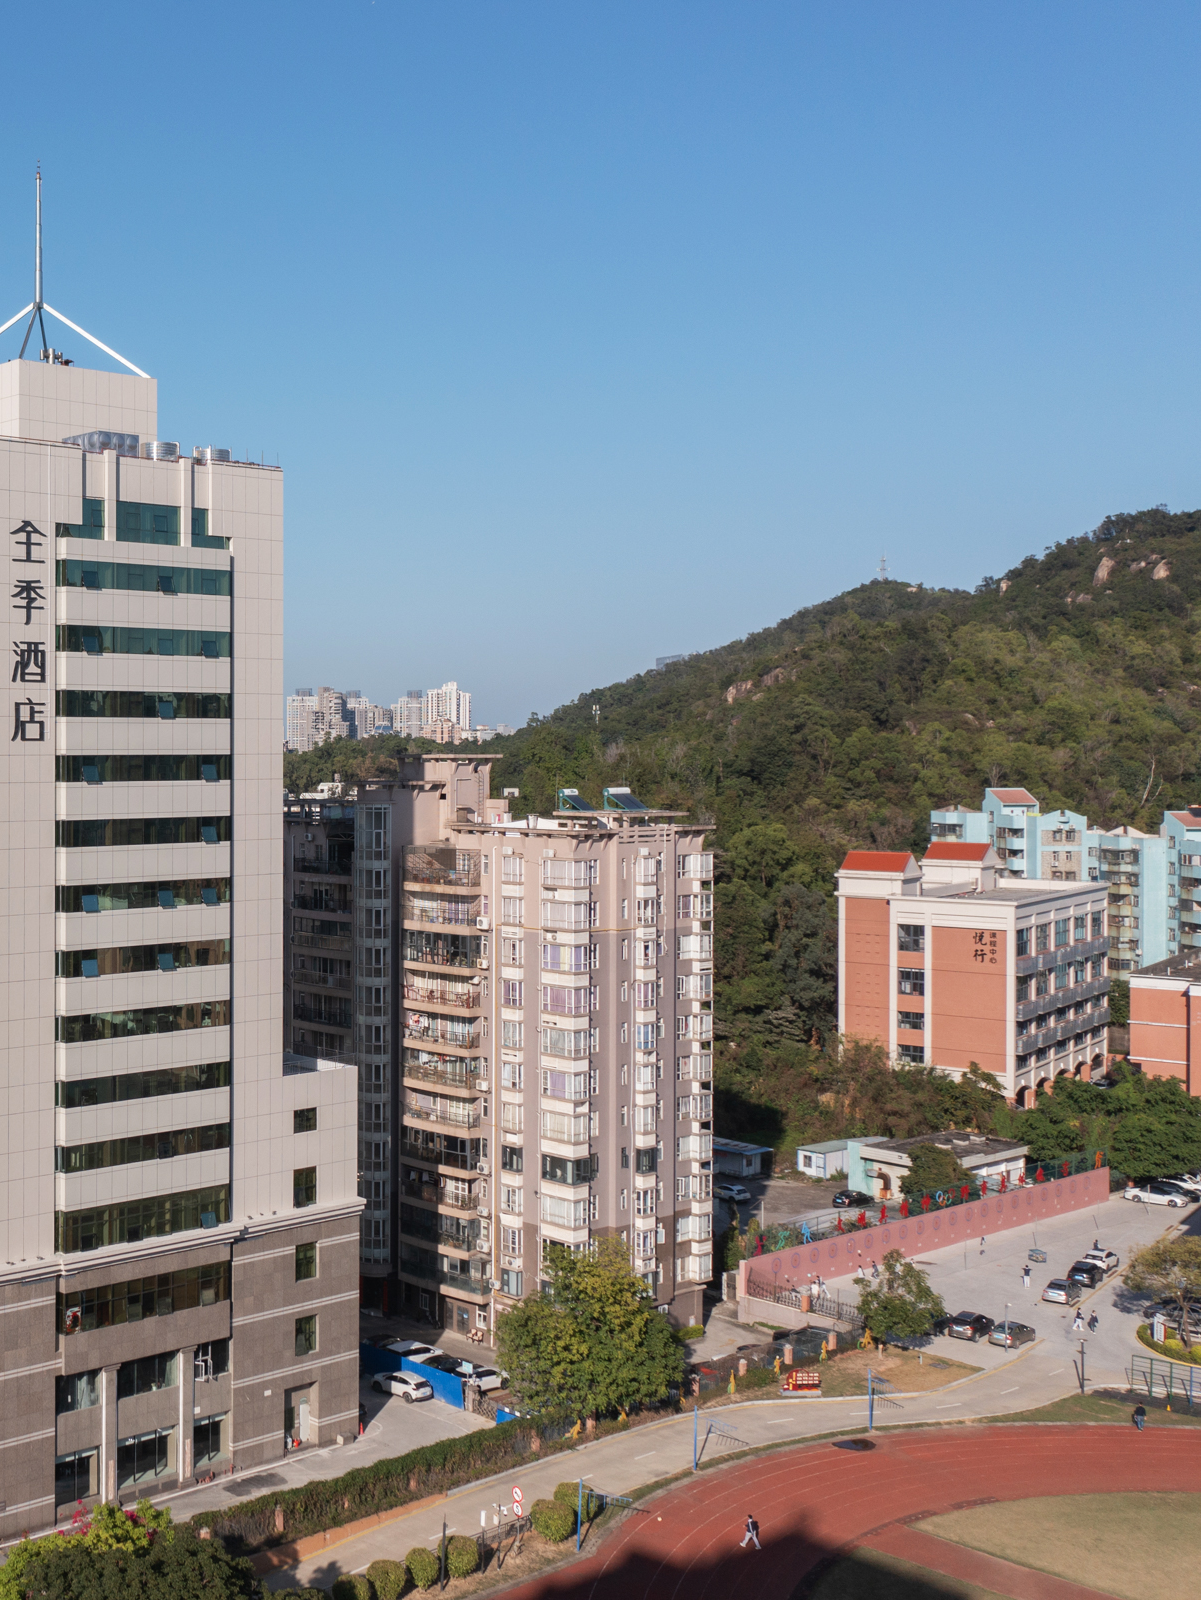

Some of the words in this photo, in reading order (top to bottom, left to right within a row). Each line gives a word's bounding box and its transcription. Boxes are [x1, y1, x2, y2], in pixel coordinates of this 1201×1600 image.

[9, 520, 48, 742] 全季酒店
[972, 931, 987, 963] 悦行
[989, 932, 997, 964] 课程中心
